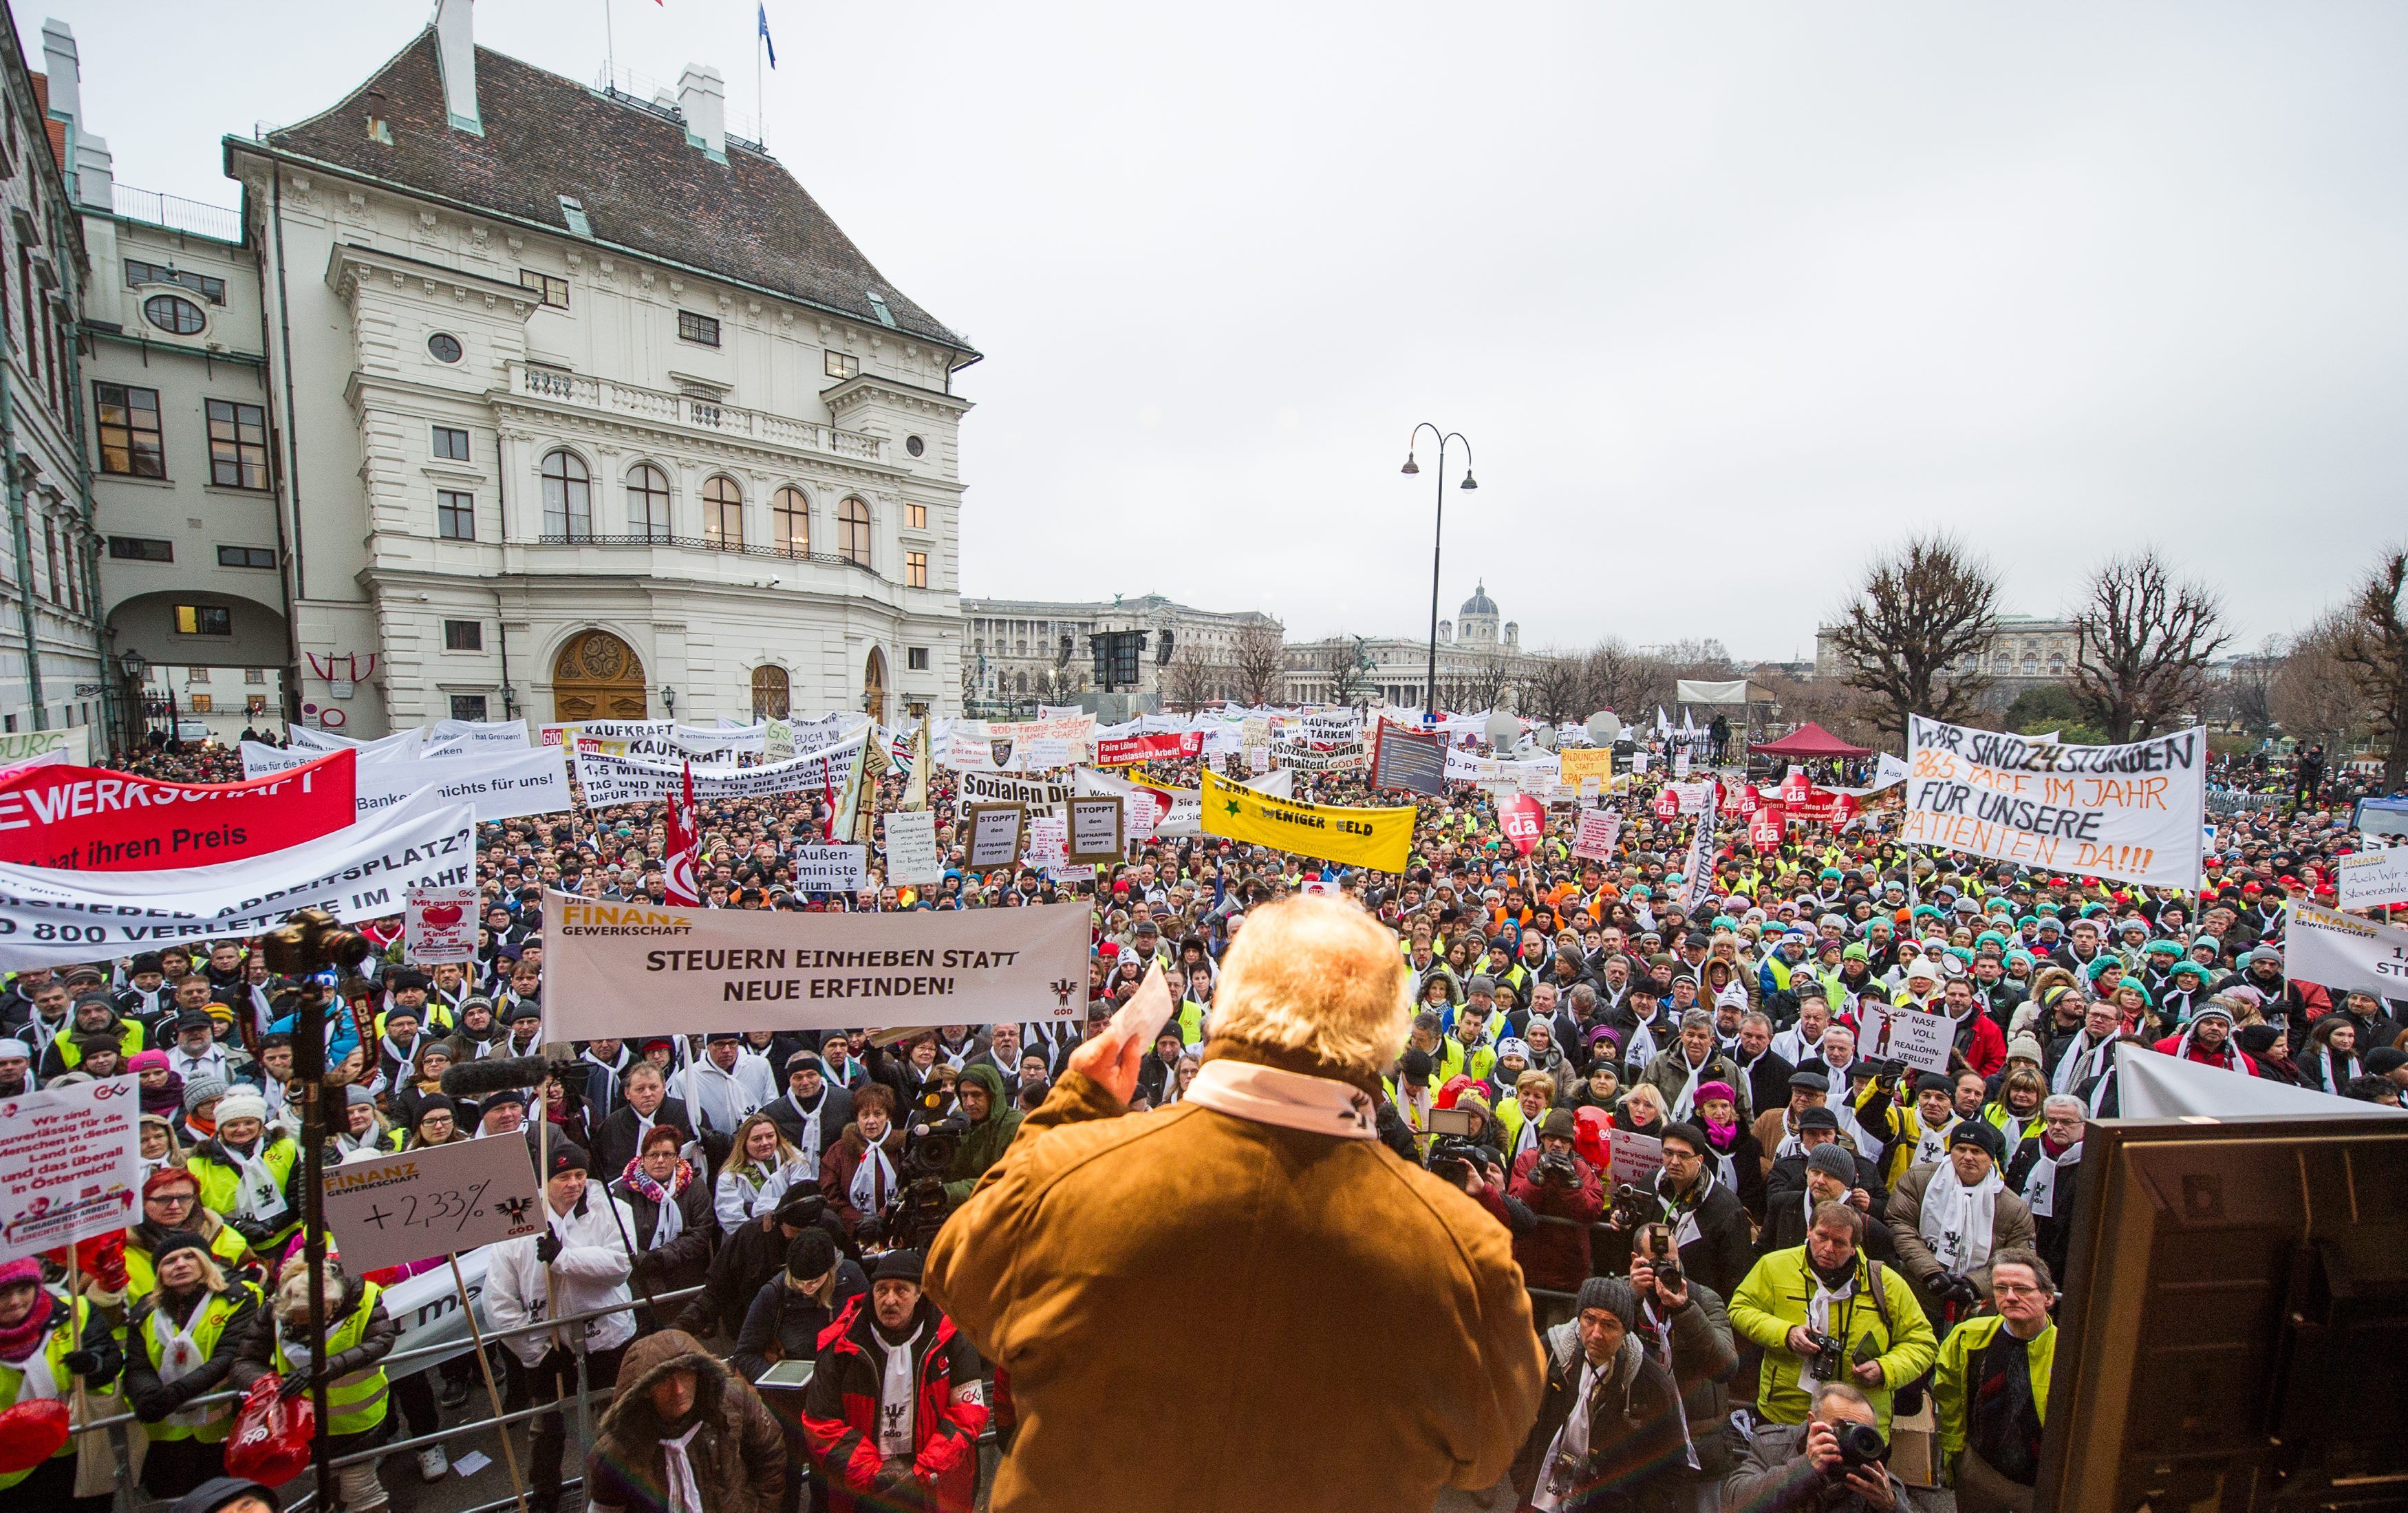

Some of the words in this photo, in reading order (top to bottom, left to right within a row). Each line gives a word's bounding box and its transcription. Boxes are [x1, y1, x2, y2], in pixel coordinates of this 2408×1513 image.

[585, 725, 674, 737] KAUFKRAFT
[1301, 717, 1360, 729] KAUFKRAFT
[543, 730, 562, 745] GÖD
[794, 732, 824, 745] EUCH
[1051, 727, 1087, 740] SPAREN
[956, 738, 984, 747] Sicherheit
[1101, 742, 1120, 752] Faire
[1120, 741, 1138, 750] Löhne
[1183, 738, 1198, 752] da
[1243, 738, 1267, 749] AHS
[1278, 741, 1325, 759] Sozialen
[1912, 716, 1964, 755] WIR
[1966, 733, 2025, 771] SIND
[2020, 742, 2063, 772] 24
[2056, 733, 2195, 773] STUNDEN
[630, 740, 733, 764] KAUFKRAFT
[951, 748, 963, 756] gibt
[1100, 753, 1111, 763] für
[1112, 750, 1153, 762] erstklassige
[1154, 747, 1180, 758] Arbeit!
[1562, 751, 1610, 762] BILDUNGSZIEL
[249, 762, 268, 773] Alles
[269, 761, 280, 771] für
[283, 760, 297, 769] die
[584, 764, 610, 777] 1,5
[1331, 759, 1353, 769] GÖD
[1574, 762, 1594, 771] STATT
[437, 782, 486, 798] nichts
[491, 777, 514, 791] für
[518, 773, 554, 788] uns!
[587, 780, 612, 791] TAG
[619, 780, 649, 789] UND
[721, 782, 749, 791] FÜR
[753, 779, 775, 788] DIE
[964, 772, 1043, 804] Sozialen
[1912, 749, 1960, 779] 365
[2045, 777, 2074, 808] IM
[2082, 777, 2169, 811] JAHR
[590, 789, 630, 803] DAFÜR
[749, 784, 789, 795] MEHR?
[799, 776, 826, 786] NEIN
[1786, 785, 1807, 802] da
[1075, 806, 1115, 814] STOPPT
[1177, 799, 1194, 807] Sie
[1658, 800, 1676, 816] da
[1741, 796, 1756, 813] da
[1916, 778, 1970, 815] FÜR
[1977, 791, 2105, 842] UNSERE
[979, 814, 1017, 824] STOPPT
[1185, 811, 1201, 821] Sie
[1261, 805, 1326, 829] WENIGER
[1336, 819, 1373, 836] GELD
[1833, 806, 1847, 824] da
[1508, 812, 1540, 837] da
[1755, 822, 1780, 842] da
[87, 837, 161, 867] ihren
[173, 824, 248, 852] Preis
[976, 841, 1015, 850] AUFNAHME-
[1903, 809, 2060, 866] PATIENTEN
[2072, 843, 2154, 875] DA!!!
[797, 848, 853, 861] Außen-
[2343, 855, 2387, 867] FINANZ
[798, 863, 858, 876] ministe
[2343, 861, 2387, 870] GEWERKSCHAFT
[2347, 872, 2376, 885] Auch
[2378, 866, 2401, 881] Wir
[799, 879, 832, 891] rium
[433, 899, 473, 908] ganzem
[564, 897, 592, 905] DIE
[2298, 903, 2314, 912] DIE
[33, 923, 107, 943] 800
[352, 888, 390, 910] IM
[563, 906, 693, 925] FINANZ
[2296, 910, 2378, 934] FINANZ
[562, 926, 693, 936] GEWERKSCHAFT
[2294, 919, 2378, 940] GEWERKSCHAFT
[646, 949, 786, 972] STEUERN
[795, 949, 934, 969] EINHEBEN
[942, 949, 1020, 969] STATT
[723, 980, 801, 1002] NEUE
[810, 976, 954, 999] ERFINDEN!
[1911, 1016, 1937, 1028] NASE
[1913, 1028, 1937, 1040] VOLL
[1894, 1040, 1942, 1056] REALLOHN-
[1898, 1051, 1935, 1066] VERLUST
[32, 1115, 60, 1127] Wir
[63, 1108, 91, 1122] sind
[0, 1122, 77, 1147] zuverlässig
[80, 1118, 99, 1129] für
[104, 1113, 123, 1124] die
[68, 1134, 80, 1143] in
[83, 1123, 129, 1139] diesem
[29, 1146, 67, 1163] Land
[69, 1143, 87, 1154] da
[1, 1167, 34, 1183] und
[38, 1161, 68, 1174] das
[72, 1146, 123, 1167] überall
[1614, 1156, 1635, 1166] rund
[1635, 1161, 1650, 1170] um
[11, 1184, 26, 1195] in
[30, 1161, 116, 1190] Österreich!
[324, 1161, 420, 1191] FINANZ
[327, 1172, 421, 1198] GEWERKSCHAFT
[14, 1226, 61, 1244] GERECHTE
[63, 1208, 119, 1230] ENTLOHNUNG
[22, 1214, 78, 1234] ENGAGIERTE
[80, 1202, 111, 1216] ARBEIT
[883, 1428, 903, 1439] GÖD
